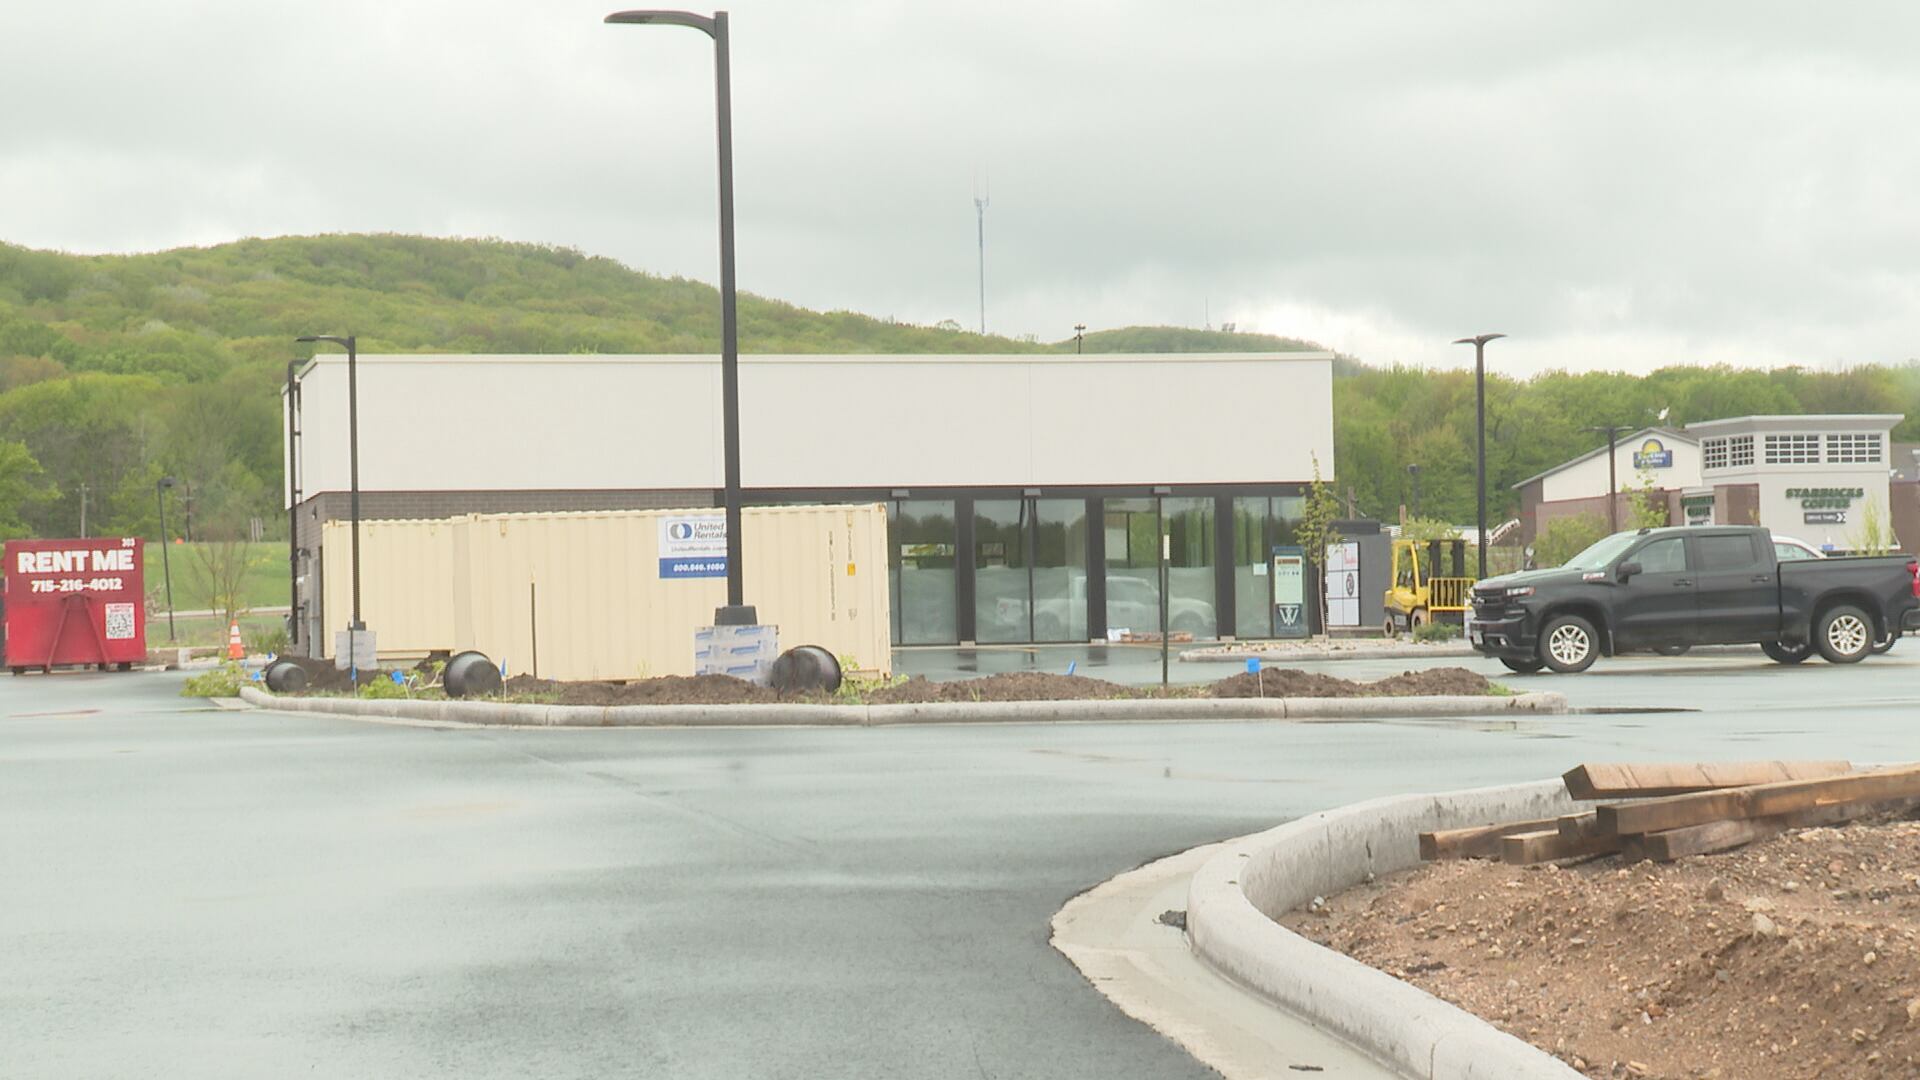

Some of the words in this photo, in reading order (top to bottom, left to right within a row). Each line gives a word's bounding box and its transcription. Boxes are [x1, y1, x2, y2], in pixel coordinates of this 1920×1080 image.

[1785, 488, 1864, 499] STARBUCKS
[1801, 499, 1851, 509] COFFEE
[694, 522, 725, 531] United
[18, 550, 90, 573] RENT
[92, 549, 135, 572] ME
[31, 578, 123, 593] 715-216-4012
